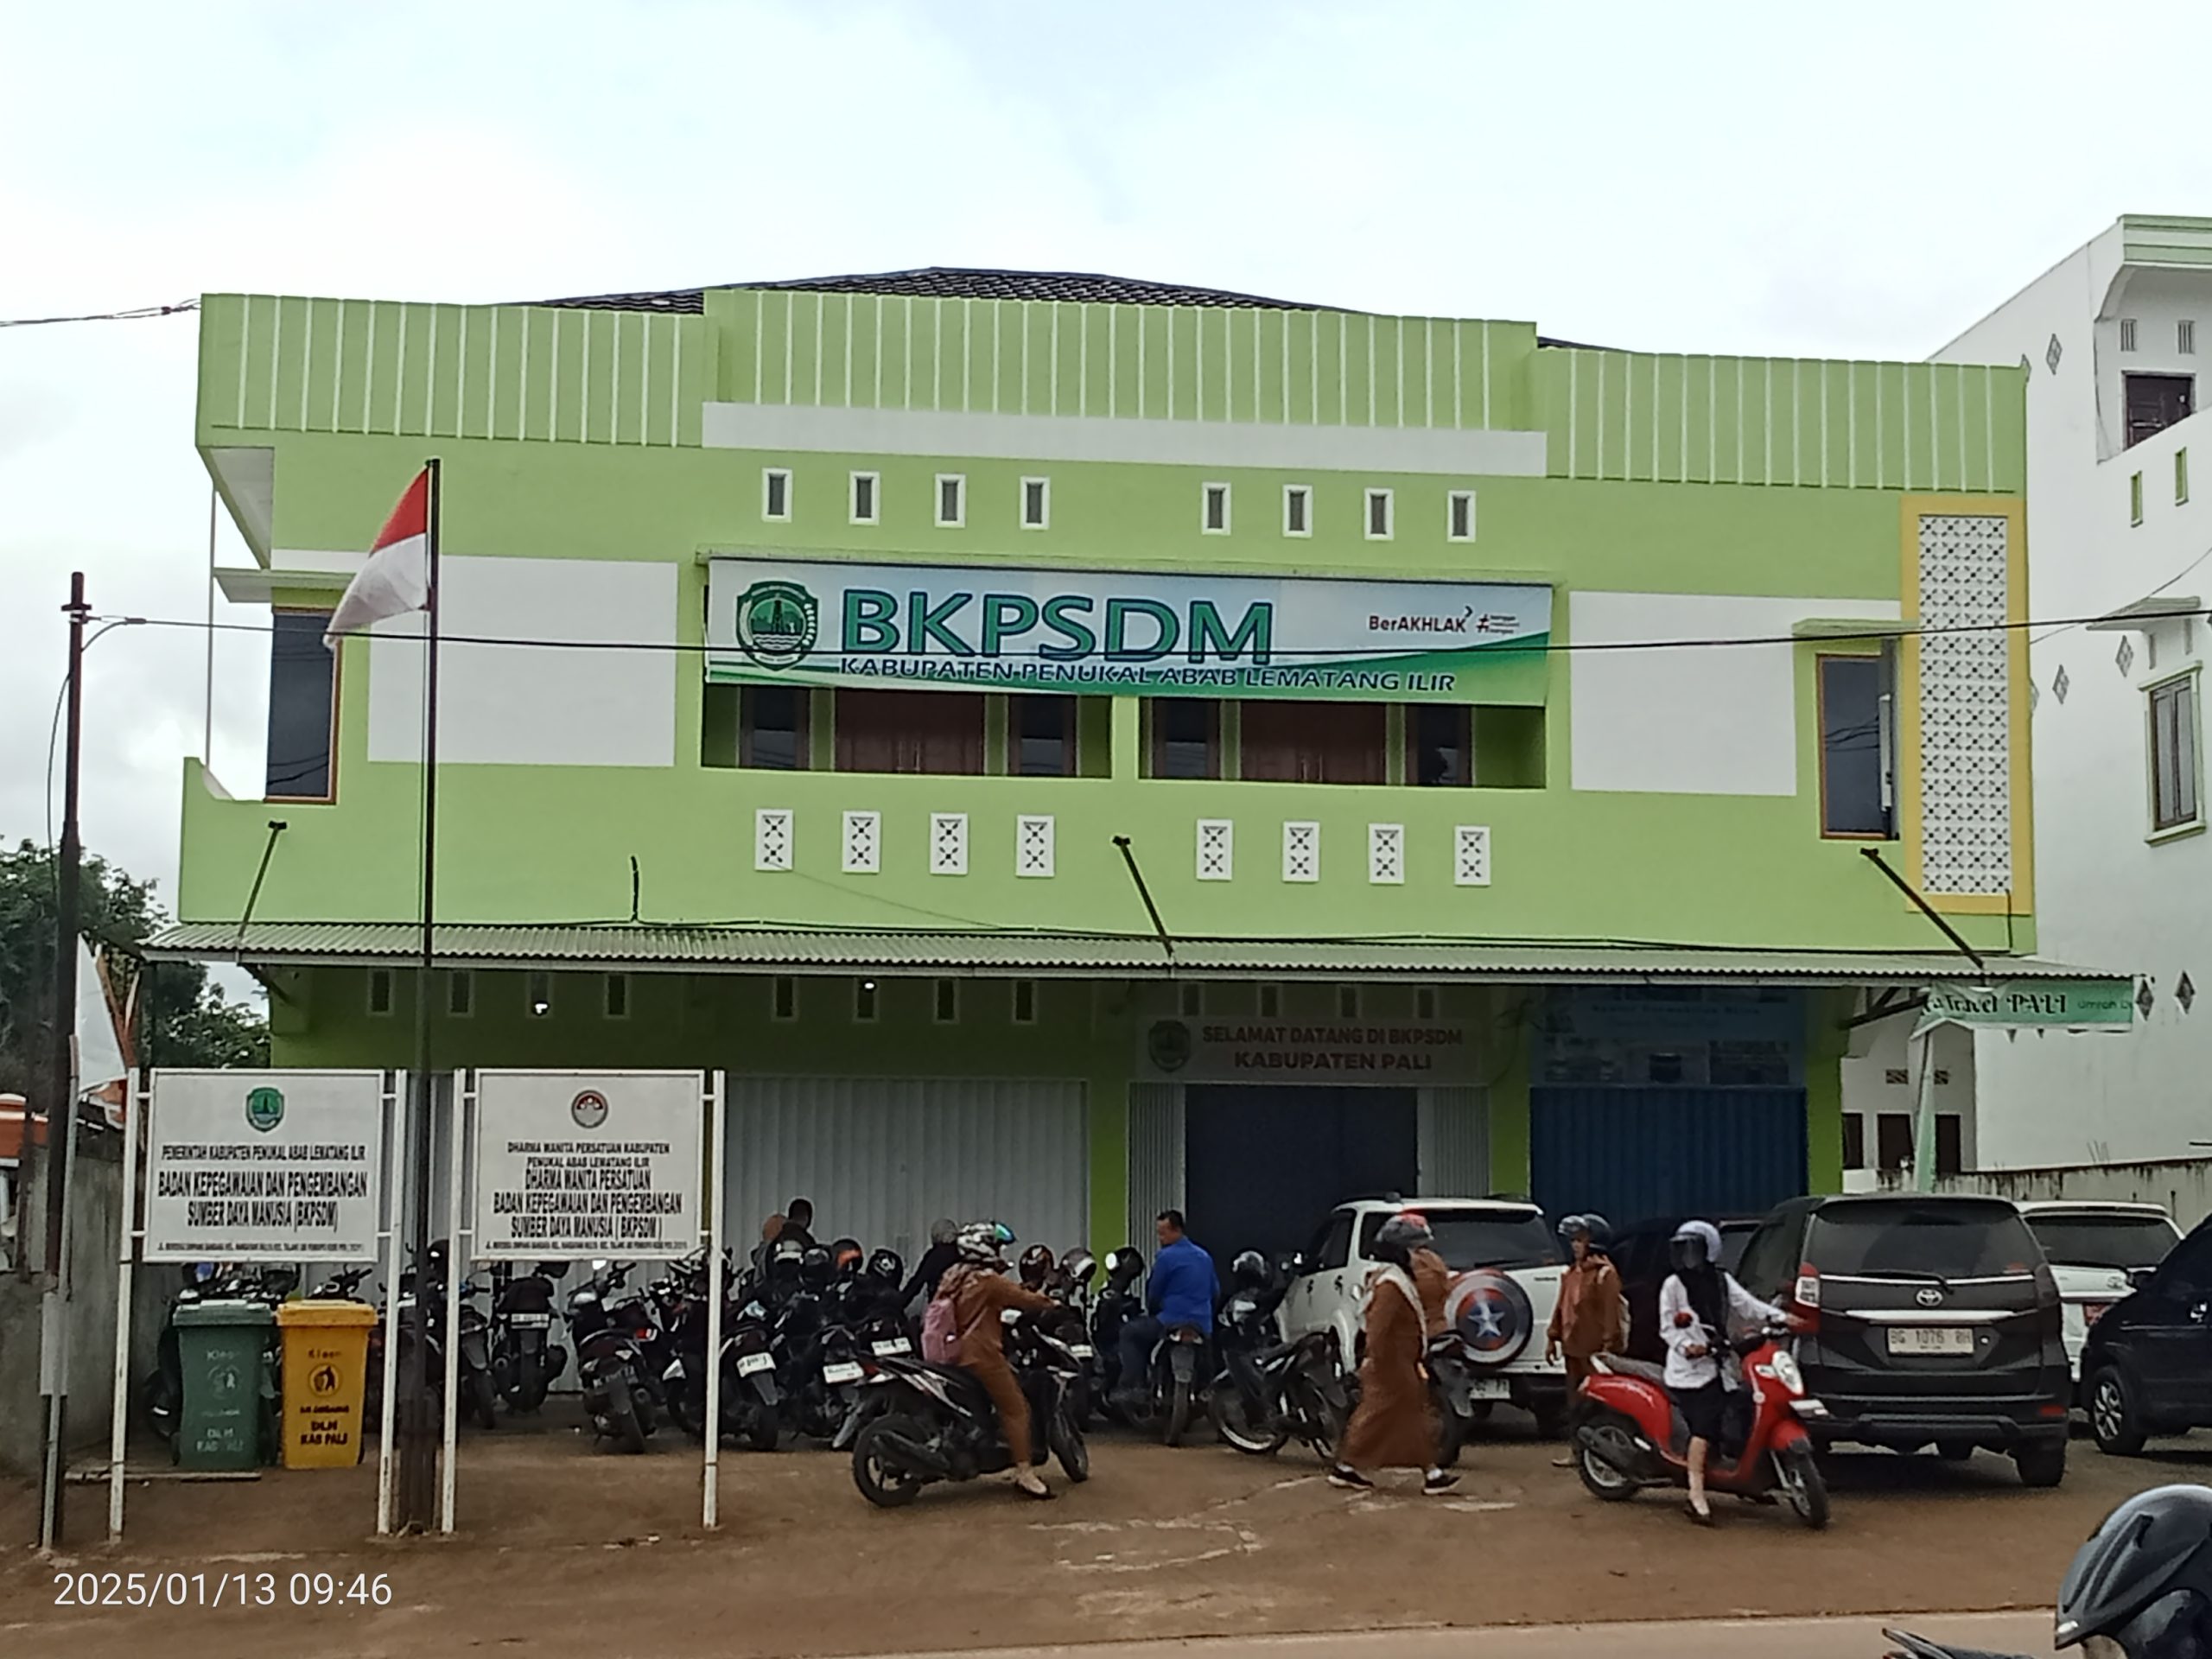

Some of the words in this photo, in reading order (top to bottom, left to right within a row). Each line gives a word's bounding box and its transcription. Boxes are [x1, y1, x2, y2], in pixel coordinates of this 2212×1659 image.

[842, 588, 1274, 665] BKPSDM
[1369, 615, 1466, 633] BerAKHLAK
[840, 657, 1014, 680] KABUPATEN
[1021, 662, 1152, 683] PENUKAL
[1159, 668, 1238, 688] ABAB
[1245, 668, 1399, 690] LEMATANG
[1408, 672, 1456, 692] ILIR
[2006, 994, 2066, 1014] PALI
[1202, 1025, 1287, 1044] SELAMAT
[1293, 1026, 1363, 1045] DATANG
[1368, 1027, 1388, 1045] DI
[1389, 1027, 1464, 1046] BKPSDM
[1234, 1051, 1376, 1071] KABUPATEN
[1382, 1052, 1433, 1071] PALI
[158, 1171, 191, 1197] BADAN
[194, 1171, 264, 1197] KEPEGAWAIAN
[266, 1171, 285, 1197] DAN
[287, 1171, 368, 1197] PENGEMBANGAN
[525, 1169, 562, 1190] DHARMA
[564, 1169, 596, 1190] WANITA
[600, 1169, 651, 1190] PERSATUAN
[188, 1201, 225, 1226] SUMBER
[227, 1201, 249, 1226] DAYA
[251, 1201, 292, 1226] MANUSIA
[494, 1192, 523, 1214] BADAN
[525, 1192, 588, 1214] KEPEGAWAIAN
[591, 1192, 608, 1214] DAN
[512, 1216, 547, 1237] SUMBER
[550, 1216, 570, 1237] DAYA
[574, 1216, 613, 1237] MANUSIA
